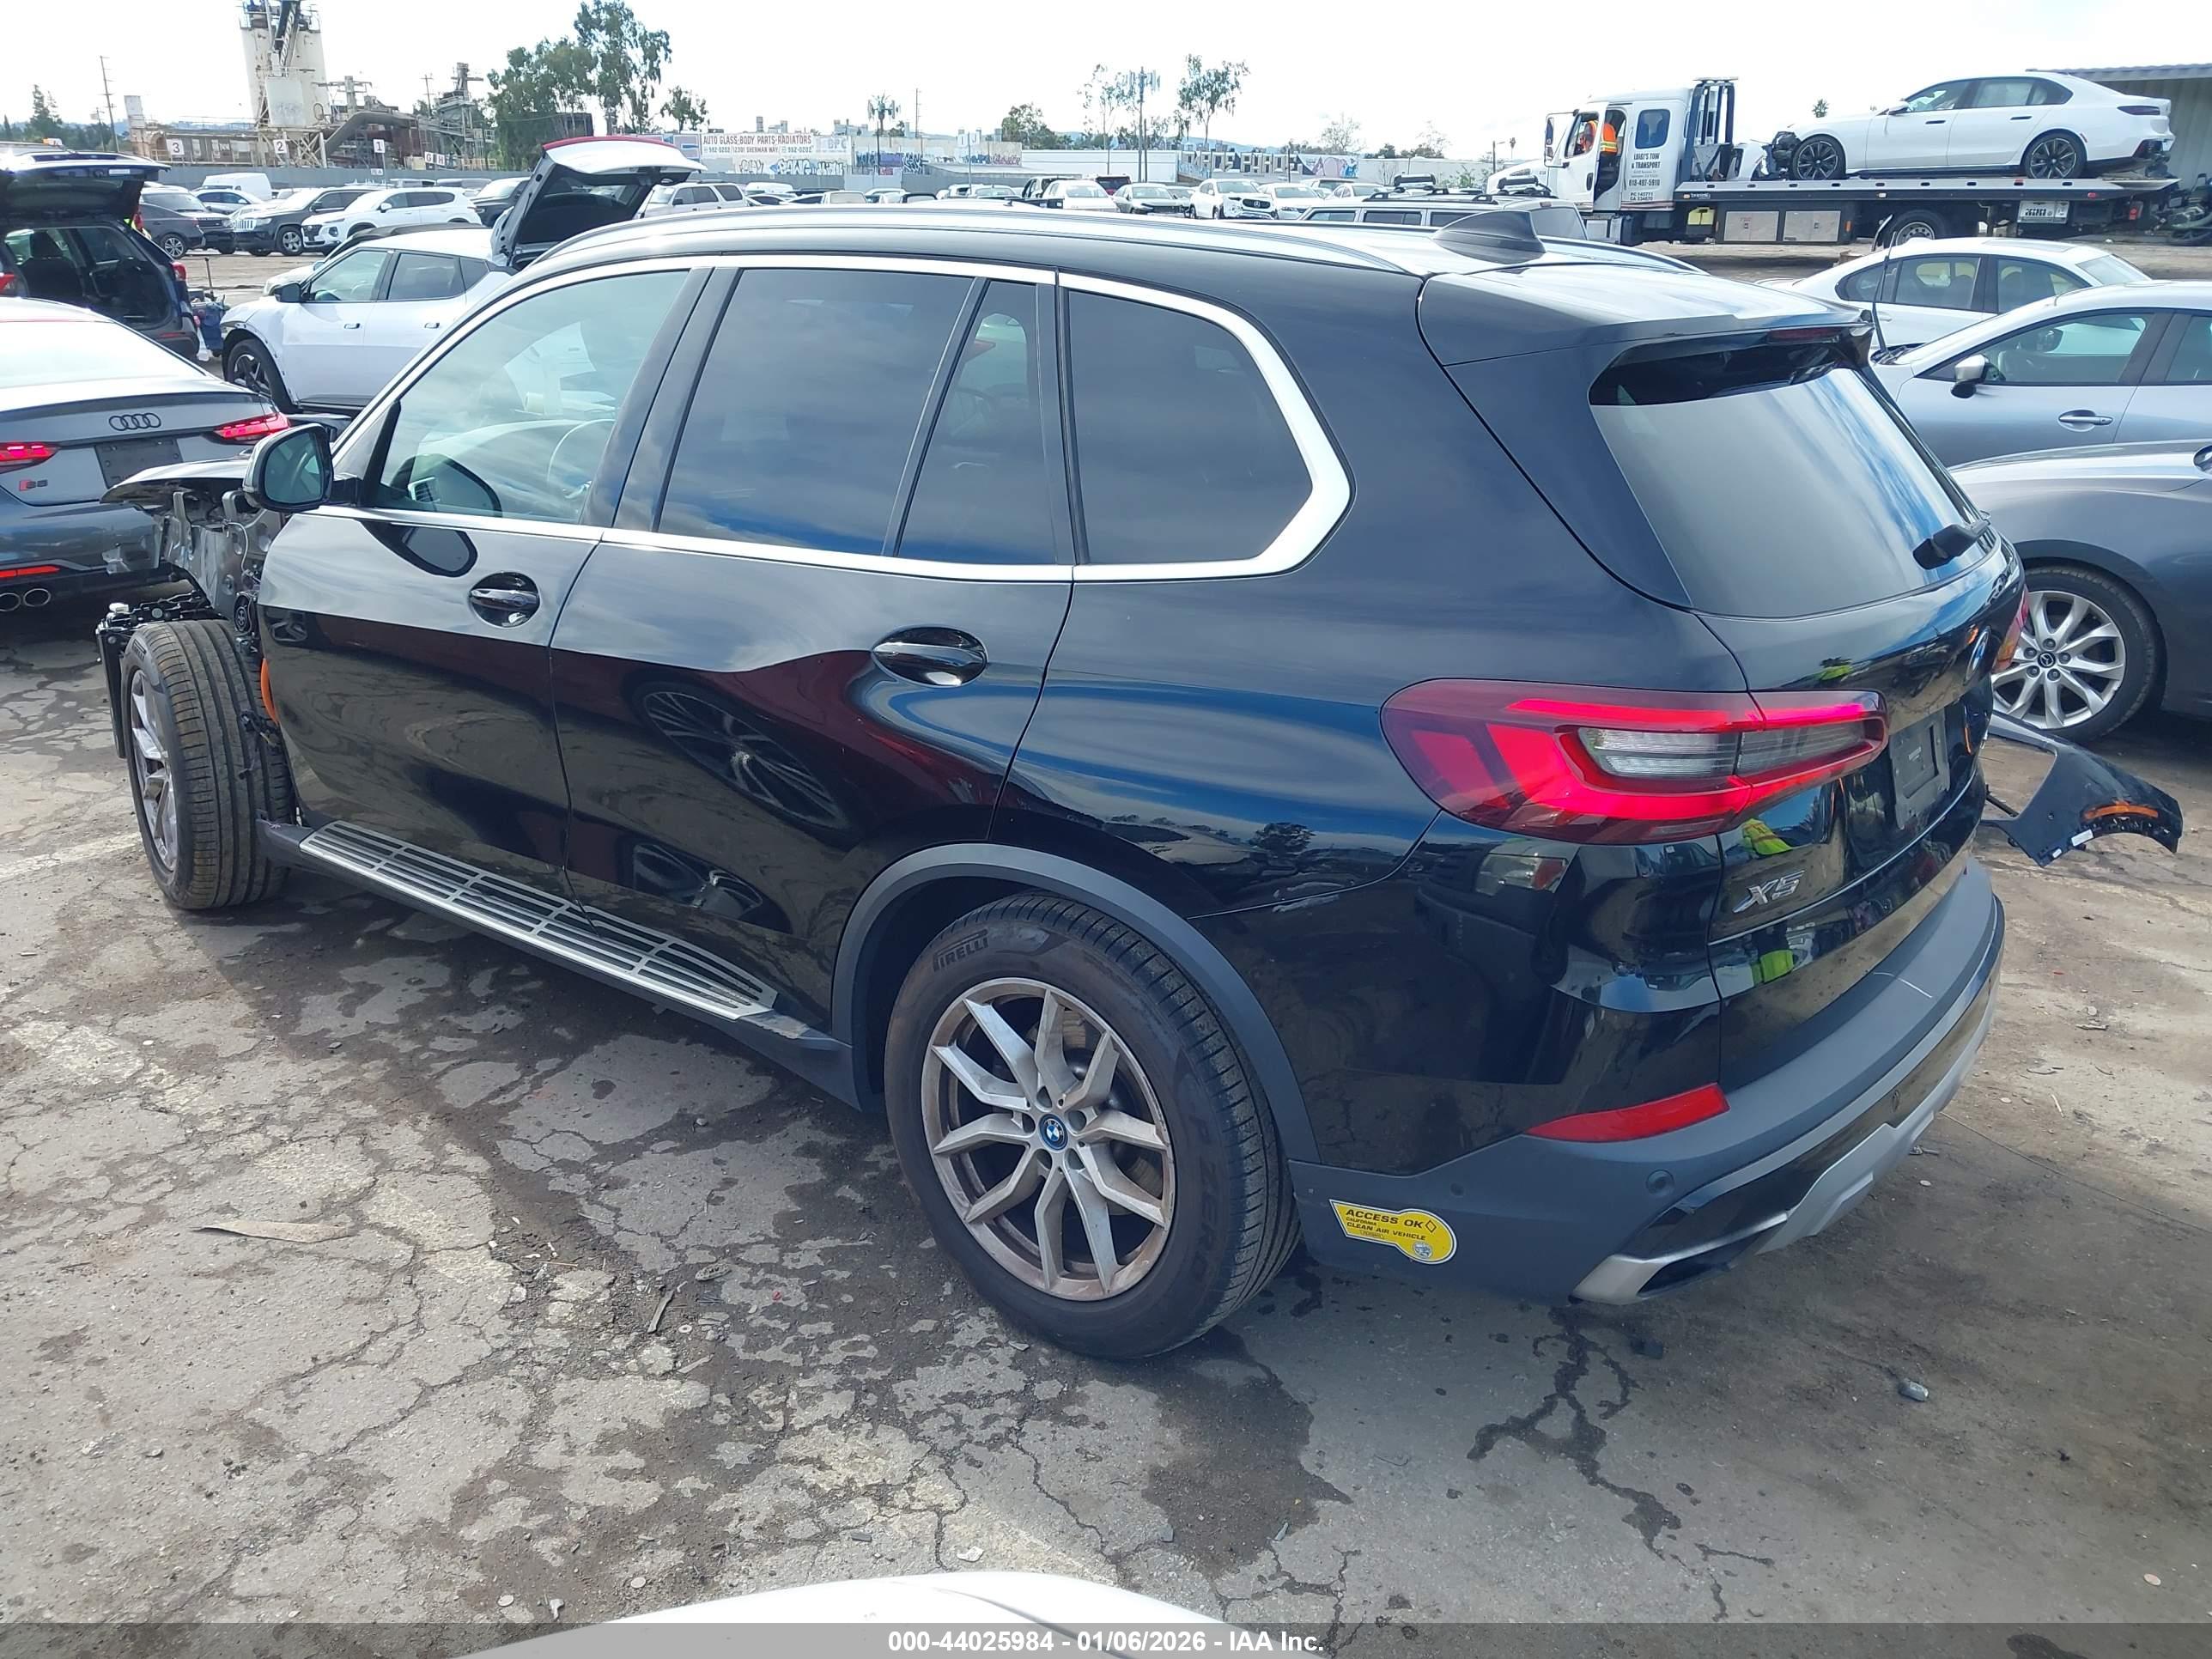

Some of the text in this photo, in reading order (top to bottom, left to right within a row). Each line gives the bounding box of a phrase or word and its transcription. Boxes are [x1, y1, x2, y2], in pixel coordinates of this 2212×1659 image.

[703, 136, 718, 145] AUTO
[173, 142, 180, 153] 3
[276, 141, 284, 151] 2
[376, 141, 382, 151] 1
[426, 153, 432, 162] G
[438, 155, 444, 165] H
[1733, 870, 1805, 913] X5
[933, 928, 989, 972] PIRELLI
[1346, 1208, 1424, 1229] ACCESS OK
[1346, 1217, 1377, 1226] CALIFORNIA
[1346, 1221, 1373, 1231] CLEAN
[1393, 1231, 1425, 1240] VEHICLE
